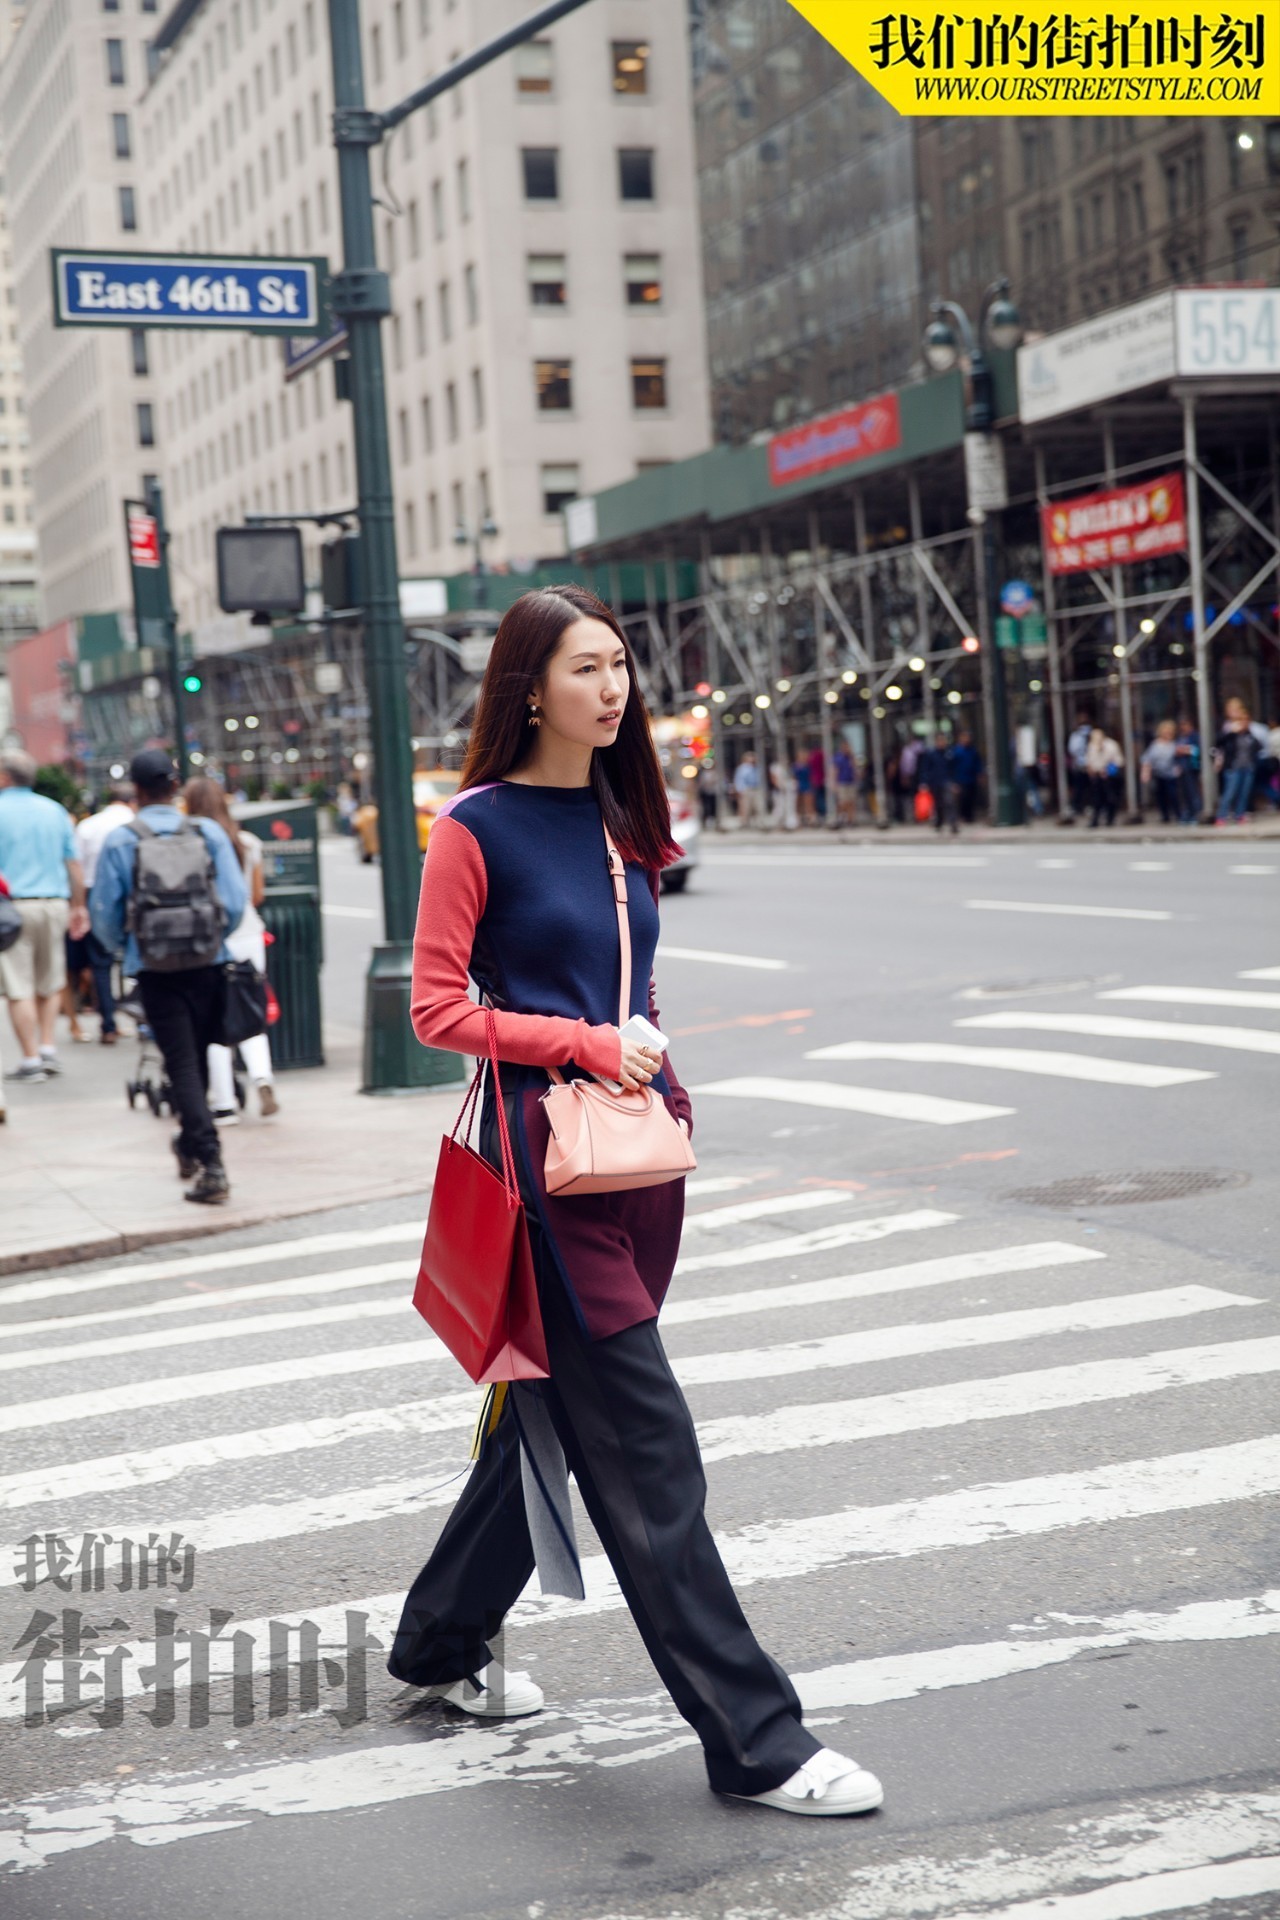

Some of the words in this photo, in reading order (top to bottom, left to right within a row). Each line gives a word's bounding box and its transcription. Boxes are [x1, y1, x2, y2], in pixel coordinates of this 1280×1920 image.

[76, 271, 163, 310] East
[168, 275, 252, 314] 46th
[257, 276, 301, 314] St
[1191, 298, 1278, 366] 554
